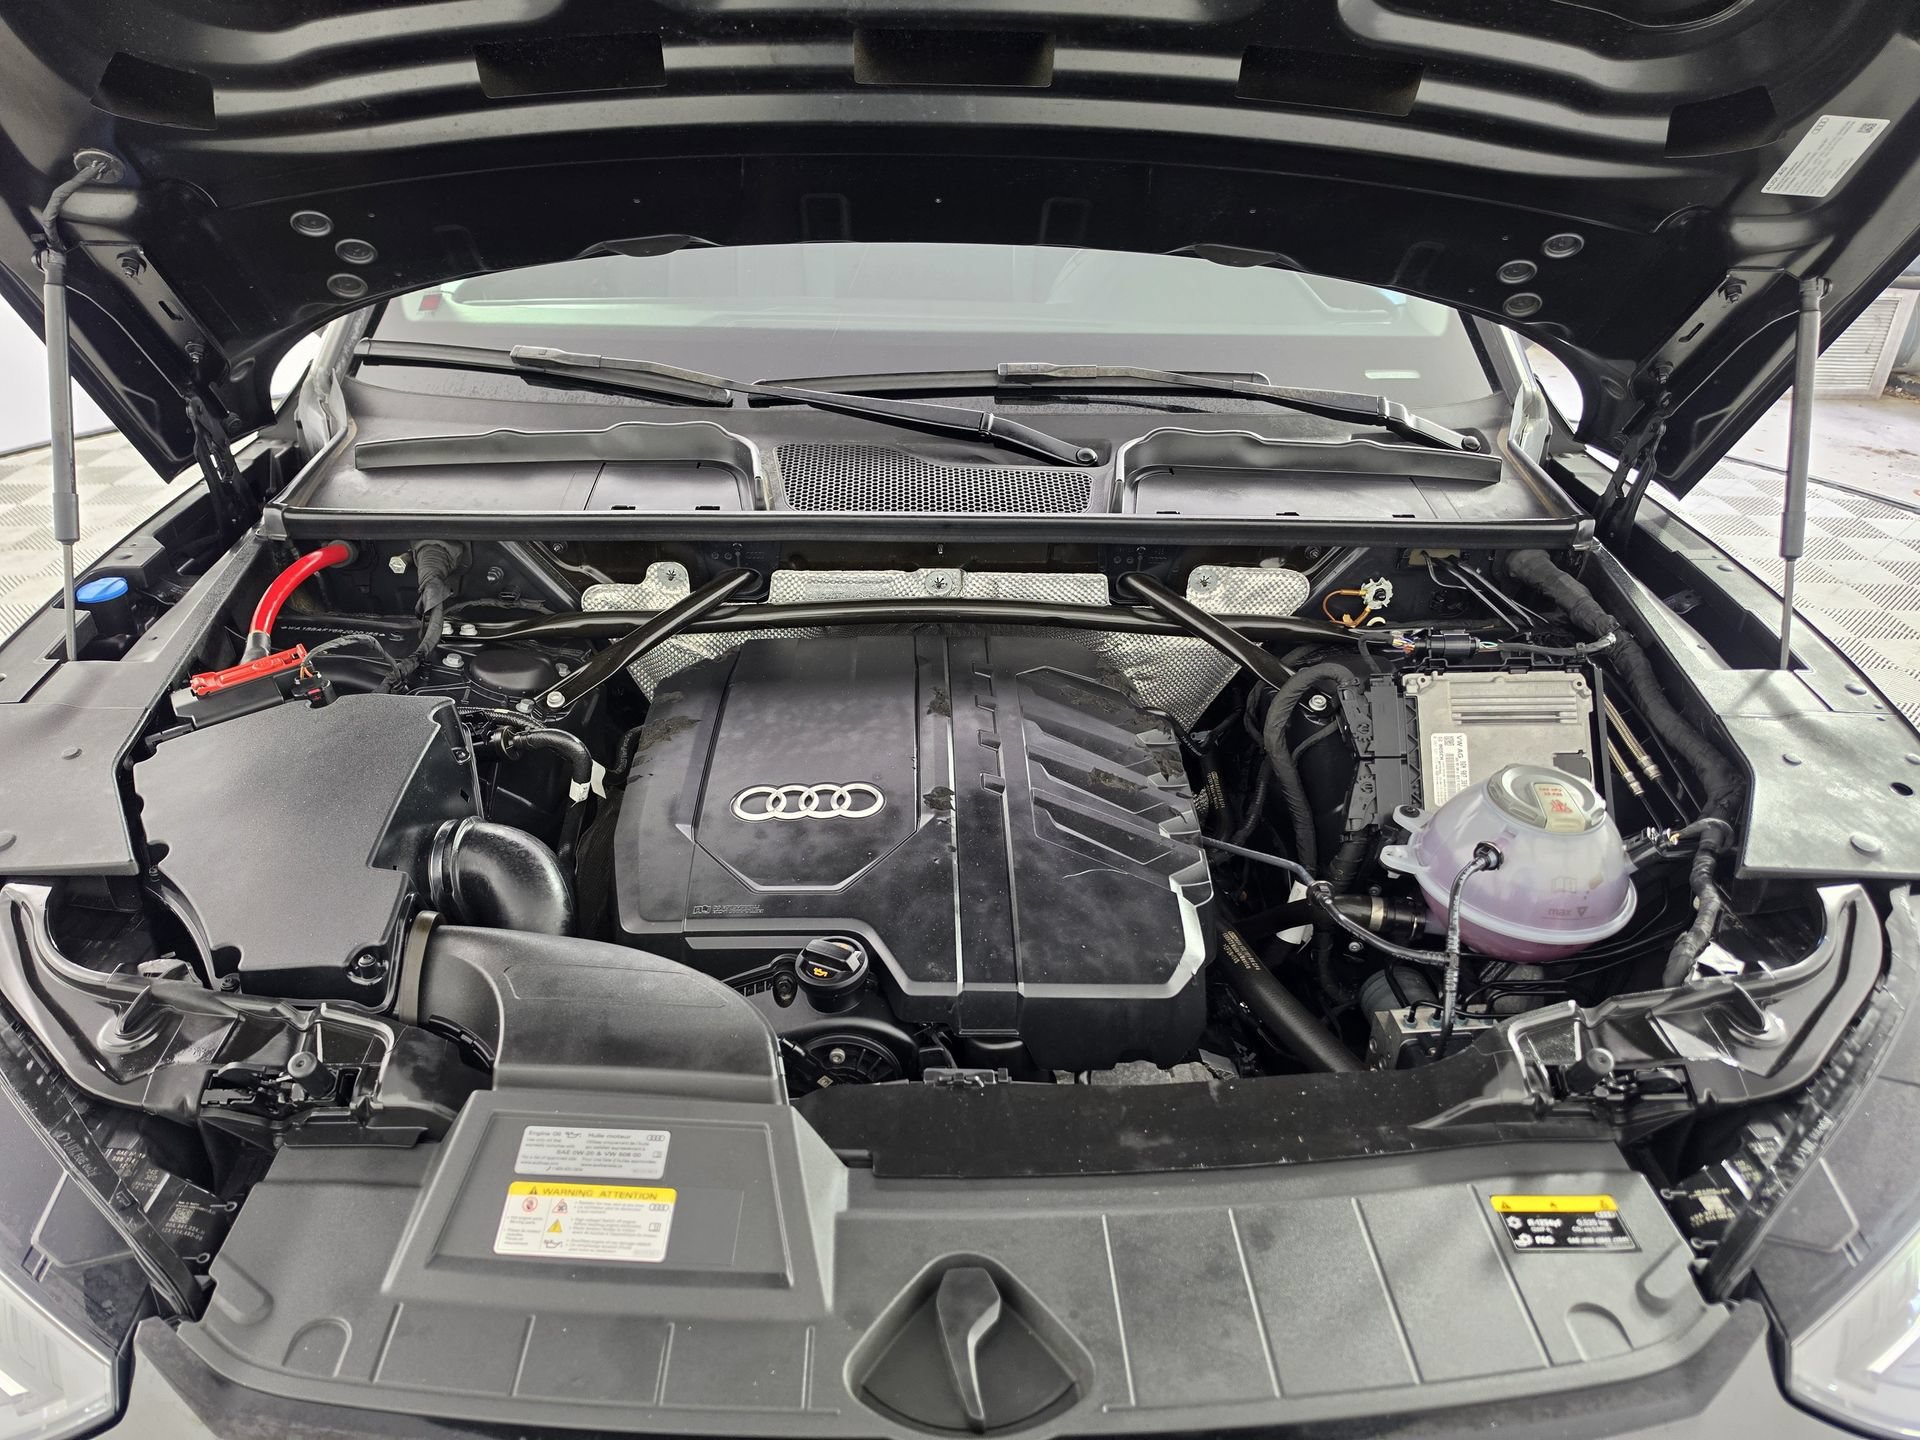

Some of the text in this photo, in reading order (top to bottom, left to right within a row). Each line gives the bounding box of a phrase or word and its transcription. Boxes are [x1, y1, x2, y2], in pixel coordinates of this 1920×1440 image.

[1456, 735, 1463, 748] VW
[1457, 749, 1464, 759] AG
[1548, 906, 1572, 916] max
[542, 1187, 658, 1201] WARNING ATTENTION
